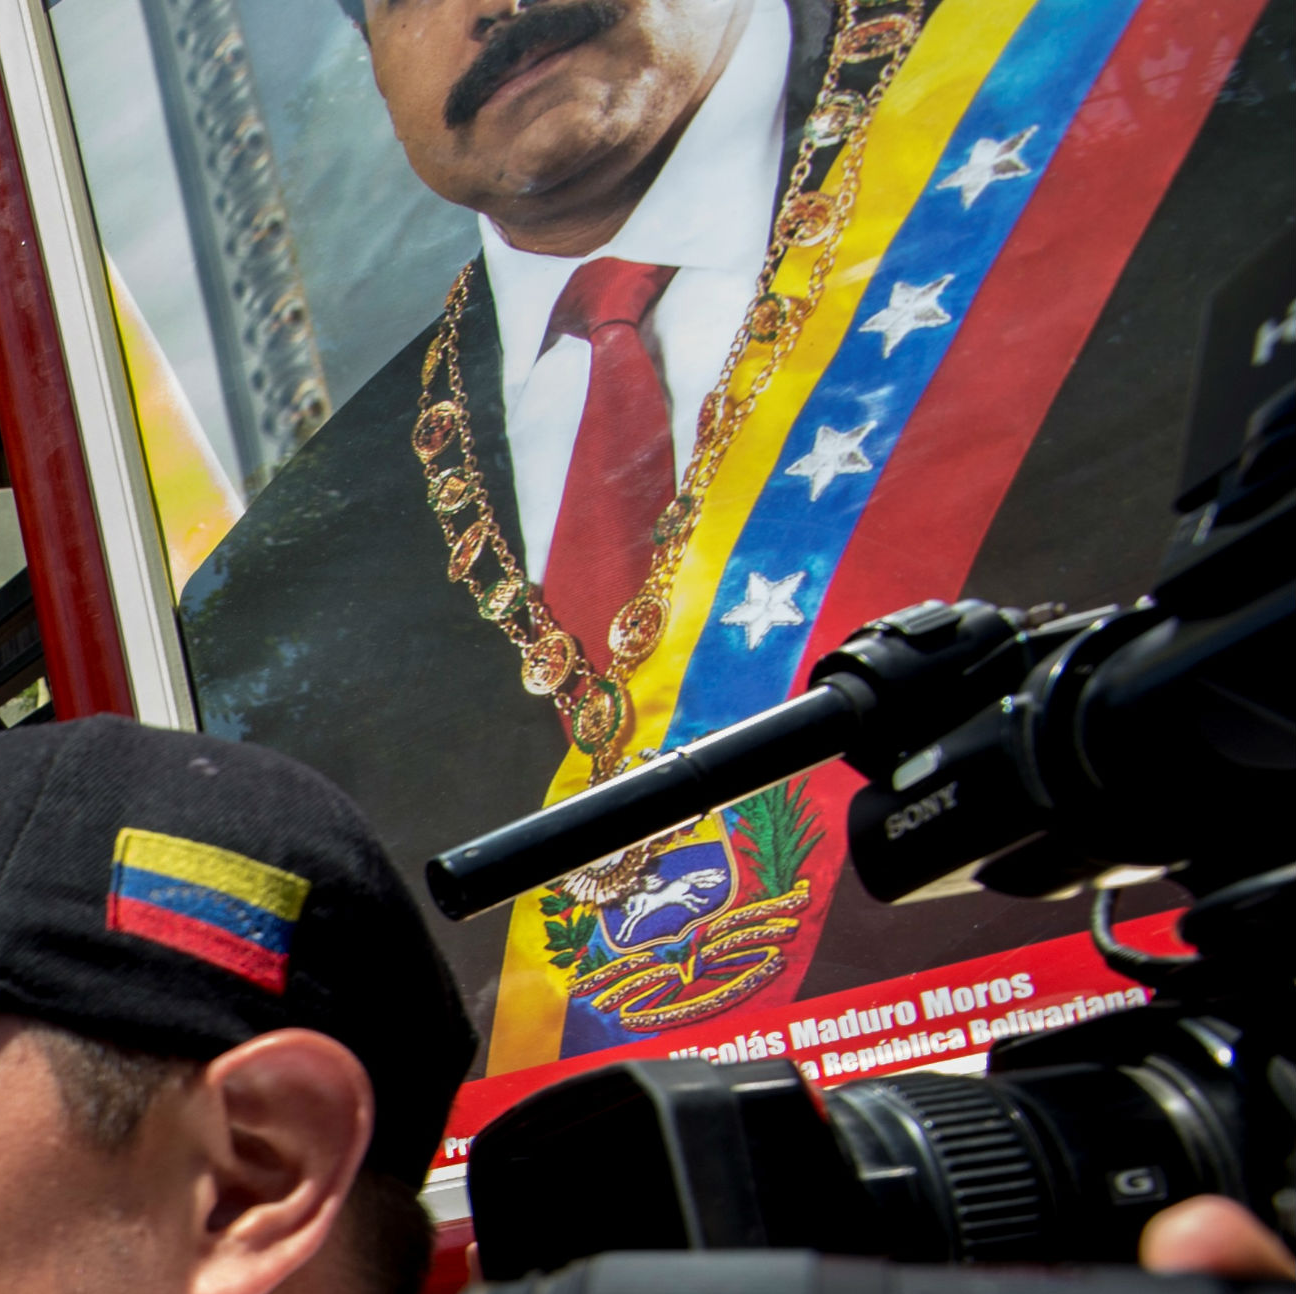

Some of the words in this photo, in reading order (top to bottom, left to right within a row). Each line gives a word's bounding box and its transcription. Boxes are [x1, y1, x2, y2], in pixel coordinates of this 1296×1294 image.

[884, 780, 959, 841] SONY
[788, 999, 917, 1051] Maduro
[919, 972, 1035, 1021] Moros
[820, 1026, 967, 1078] República
[967, 986, 1148, 1046] Bolivariana
